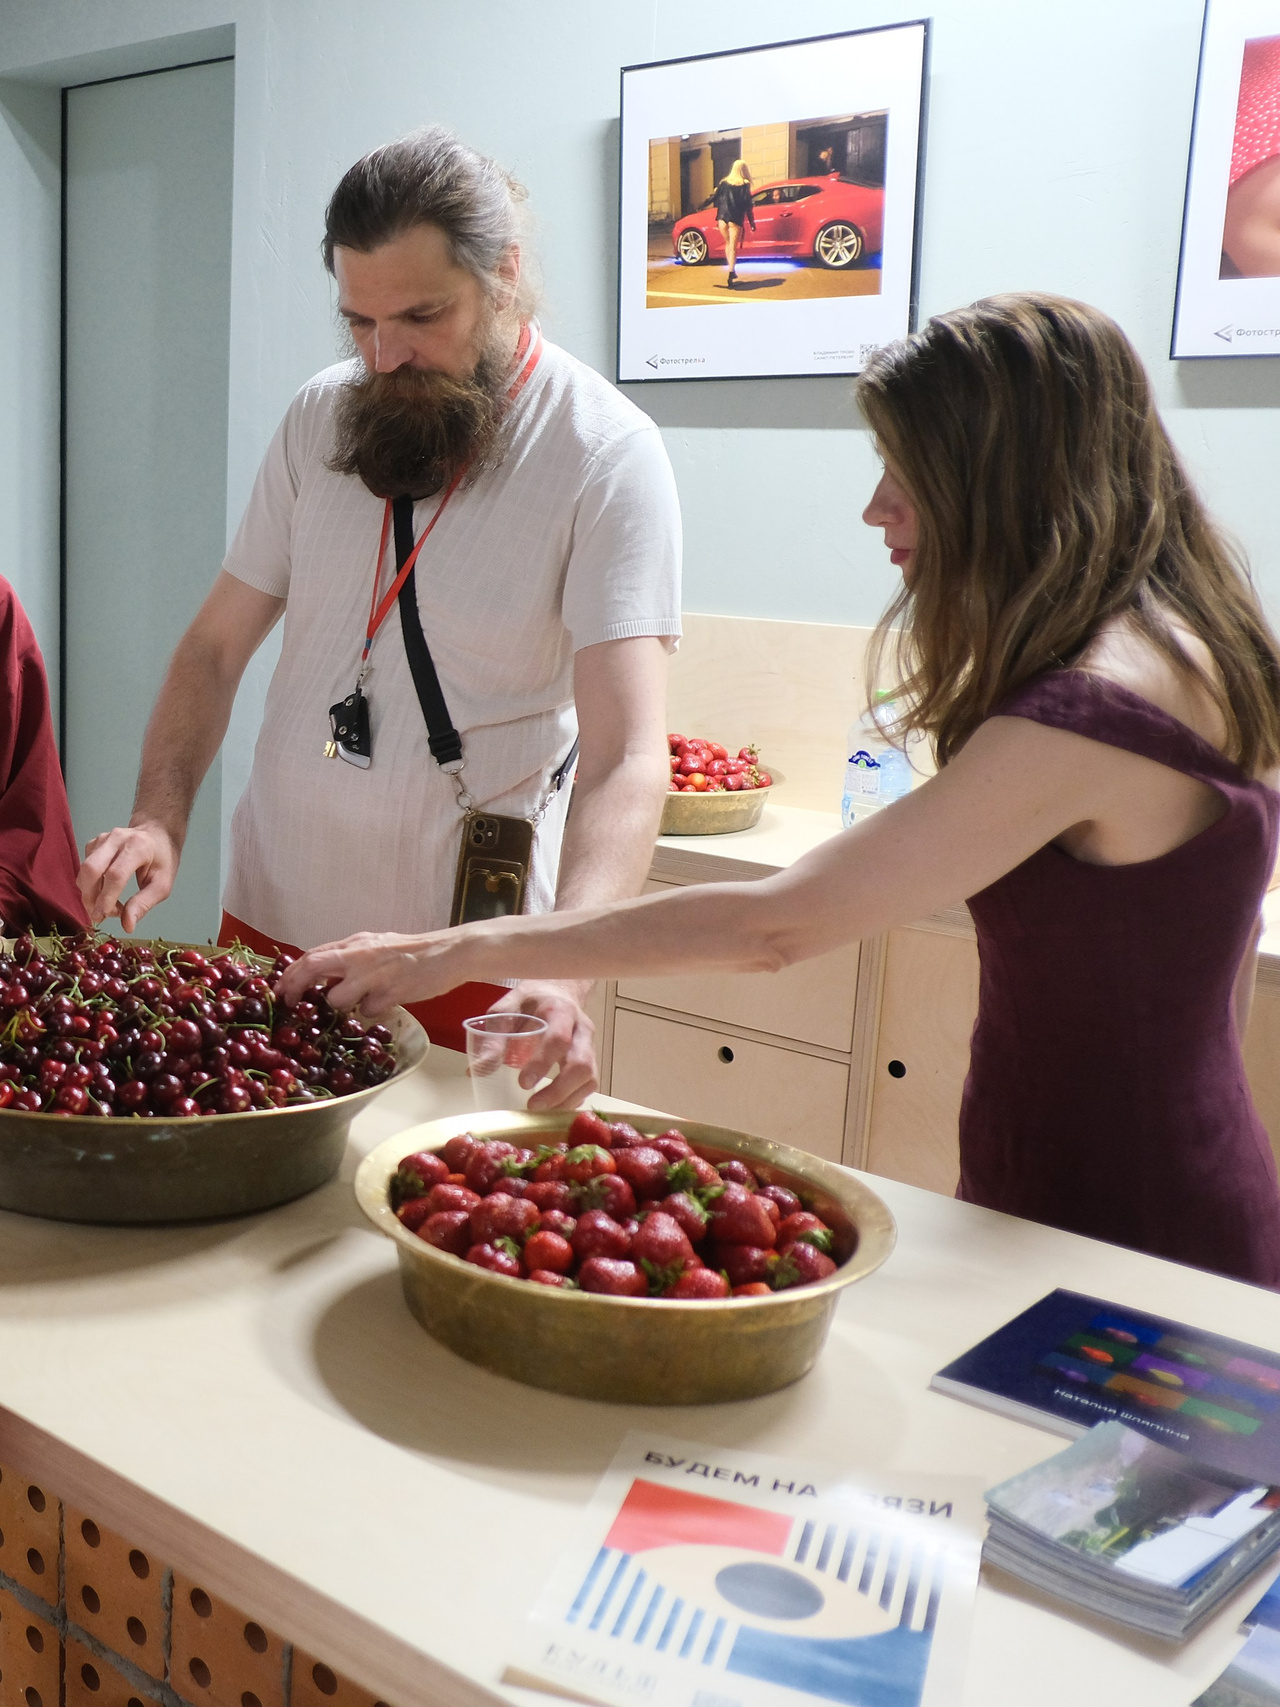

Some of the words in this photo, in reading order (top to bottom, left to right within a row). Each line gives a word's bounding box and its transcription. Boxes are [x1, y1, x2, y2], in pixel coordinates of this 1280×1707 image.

[660, 358, 705, 366] Фотострелка
[644, 1451, 760, 1488] БУДЕМ
[772, 1479, 818, 1497] НА
[846, 1489, 954, 1519] ЯЗИ
